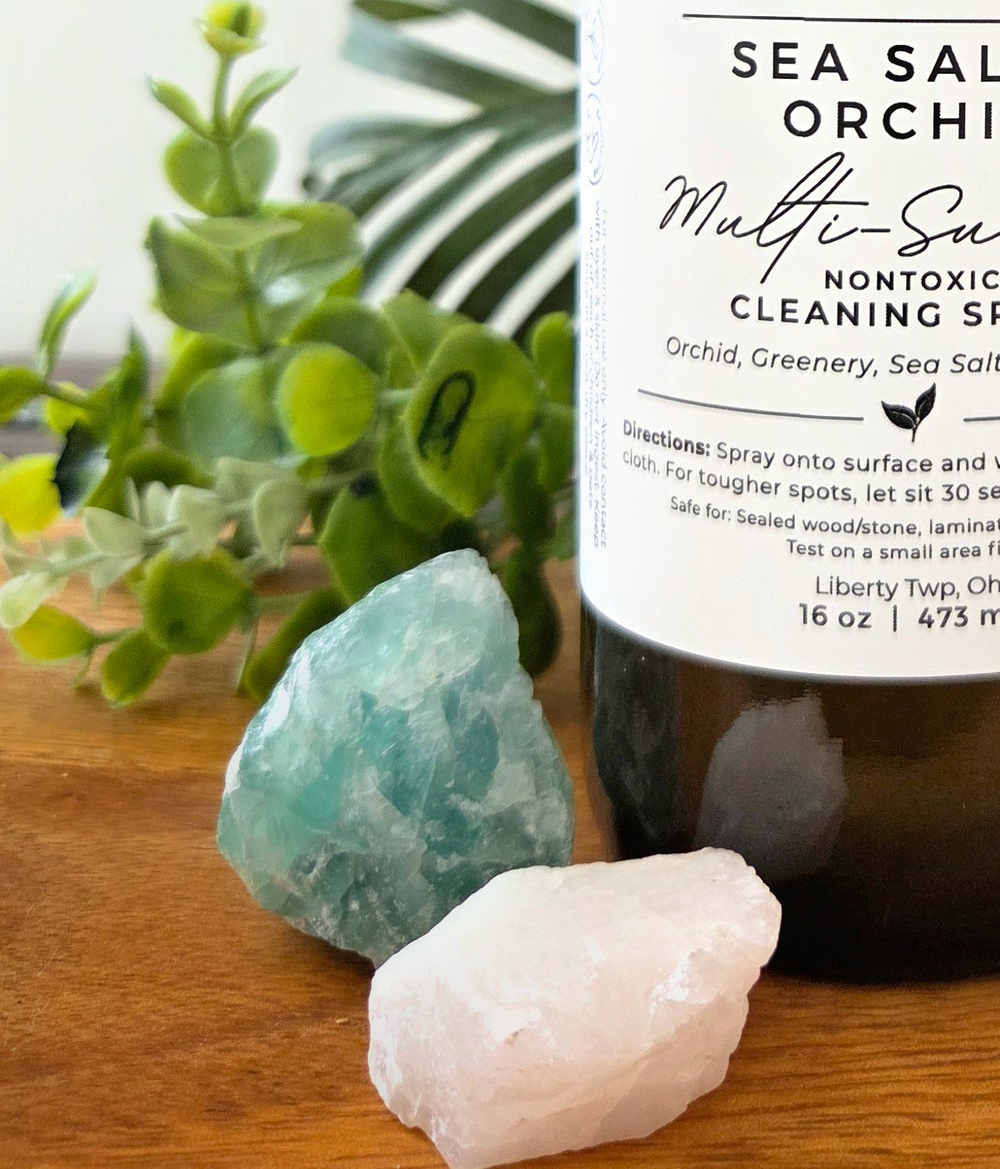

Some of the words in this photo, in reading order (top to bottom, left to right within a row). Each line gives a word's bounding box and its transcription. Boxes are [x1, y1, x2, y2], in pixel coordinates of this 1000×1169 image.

[732, 41, 849, 81] SEA
[825, 270, 999, 291] NONTOXIC
[731, 294, 940, 327] CLEANING
[667, 336, 741, 369] Orchid,
[752, 348, 878, 379] Greenery,
[889, 354, 940, 374] Sea
[623, 420, 710, 461] Directions:
[717, 442, 775, 469] Spray
[783, 454, 835, 470] onto
[844, 454, 933, 473] surface
[941, 452, 985, 472] and
[623, 449, 659, 474] cloth.
[666, 461, 692, 481] For
[699, 469, 781, 495] tougher
[789, 484, 857, 505] spots,
[867, 484, 896, 502] let
[905, 484, 933, 503] sit
[942, 484, 970, 502] 30
[671, 496, 700, 515] Safe
[706, 503, 731, 521] for:
[737, 509, 795, 529] Sealed
[802, 518, 921, 537] wood/stone,
[786, 539, 824, 557] Test
[831, 546, 854, 558] on
[862, 548, 872, 559] a
[880, 544, 932, 559] small
[940, 546, 981, 559] area
[816, 576, 898, 602] Liberty
[904, 579, 960, 601] Twp,
[967, 574, 1000, 595] Oh
[799, 603, 827, 626] 16
[838, 611, 872, 629] oz
[918, 606, 968, 629] 473
